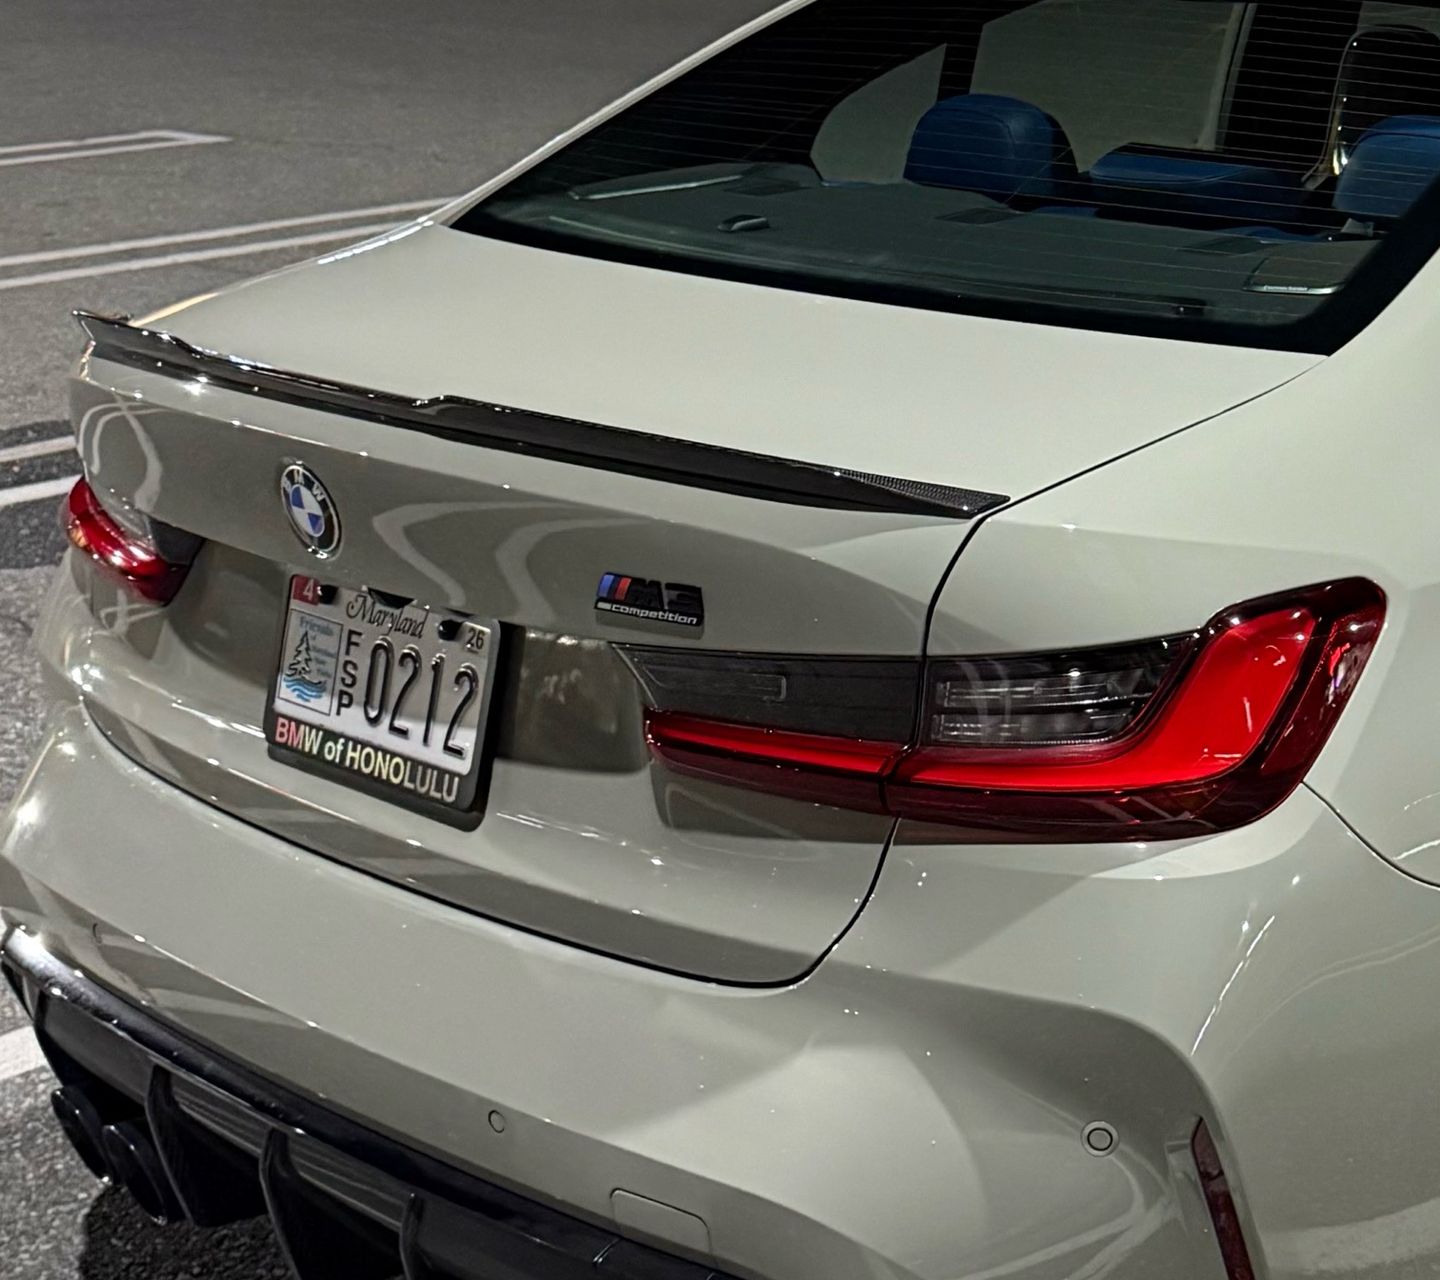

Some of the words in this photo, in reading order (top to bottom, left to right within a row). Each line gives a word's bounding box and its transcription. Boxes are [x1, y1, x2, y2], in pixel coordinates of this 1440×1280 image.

[303, 578, 314, 601] 4
[346, 594, 429, 639] Maryland
[611, 604, 698, 625] competition
[467, 627, 485, 651] 26
[363, 634, 480, 760] 0212
[275, 717, 323, 755] BMW
[324, 739, 344, 765] of
[346, 742, 460, 803] HONOLULU
